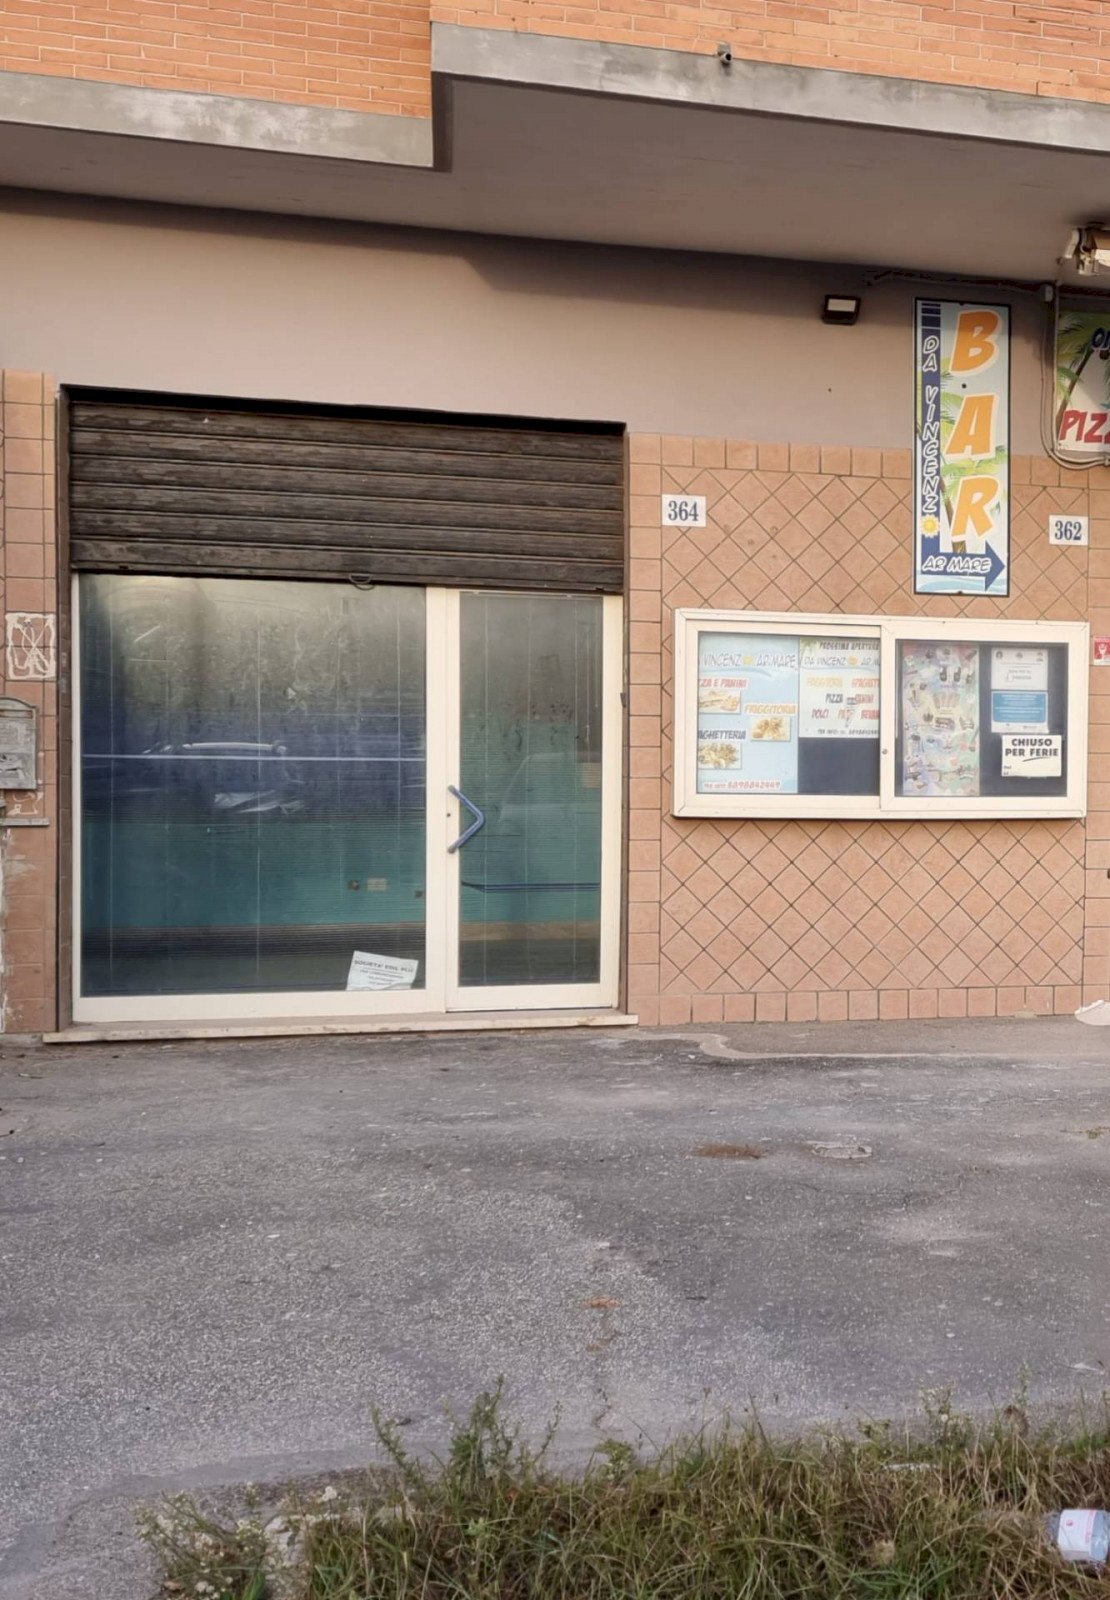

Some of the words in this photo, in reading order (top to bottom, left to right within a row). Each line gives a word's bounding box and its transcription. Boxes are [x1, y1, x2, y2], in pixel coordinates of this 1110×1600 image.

[922, 335, 939, 372] DA
[946, 310, 1000, 541] BAR
[668, 500, 699, 521] 364
[1055, 520, 1083, 541] 362
[922, 557, 945, 573] AR
[947, 557, 992, 573] MARE
[1005, 748, 1025, 757] PER
[1029, 748, 1059, 757] FERIE
[1011, 738, 1053, 747] CHIUSO
